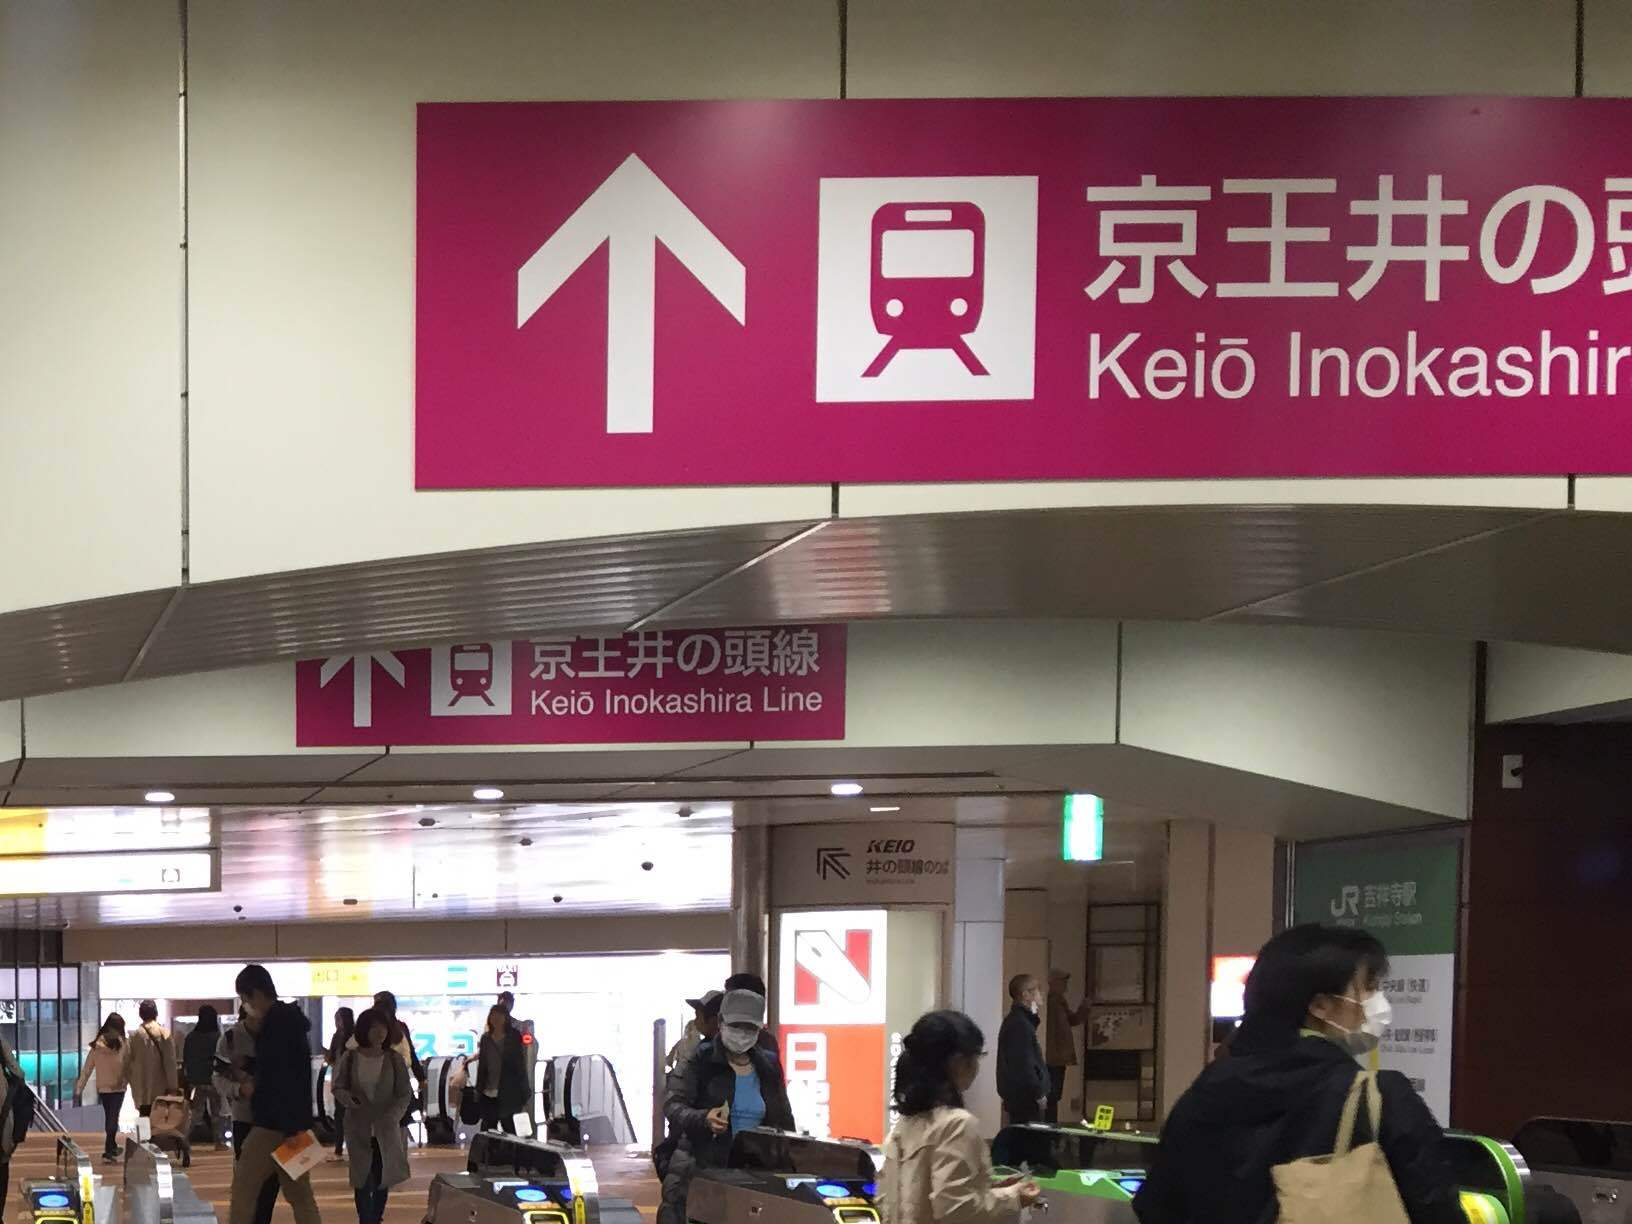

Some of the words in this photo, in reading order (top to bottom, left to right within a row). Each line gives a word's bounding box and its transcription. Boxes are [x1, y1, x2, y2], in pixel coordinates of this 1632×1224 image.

[1084, 174, 1632, 304] 京王井の
[1088, 331, 1256, 400] Keiō
[1289, 329, 1632, 398] Inokashir
[529, 629, 820, 680] 京王井の頭線
[531, 689, 595, 716] Keiō
[605, 687, 753, 715] Inokashira
[763, 685, 823, 712] Line
[867, 839, 916, 854] KEIO
[1331, 885, 1359, 918] JR
